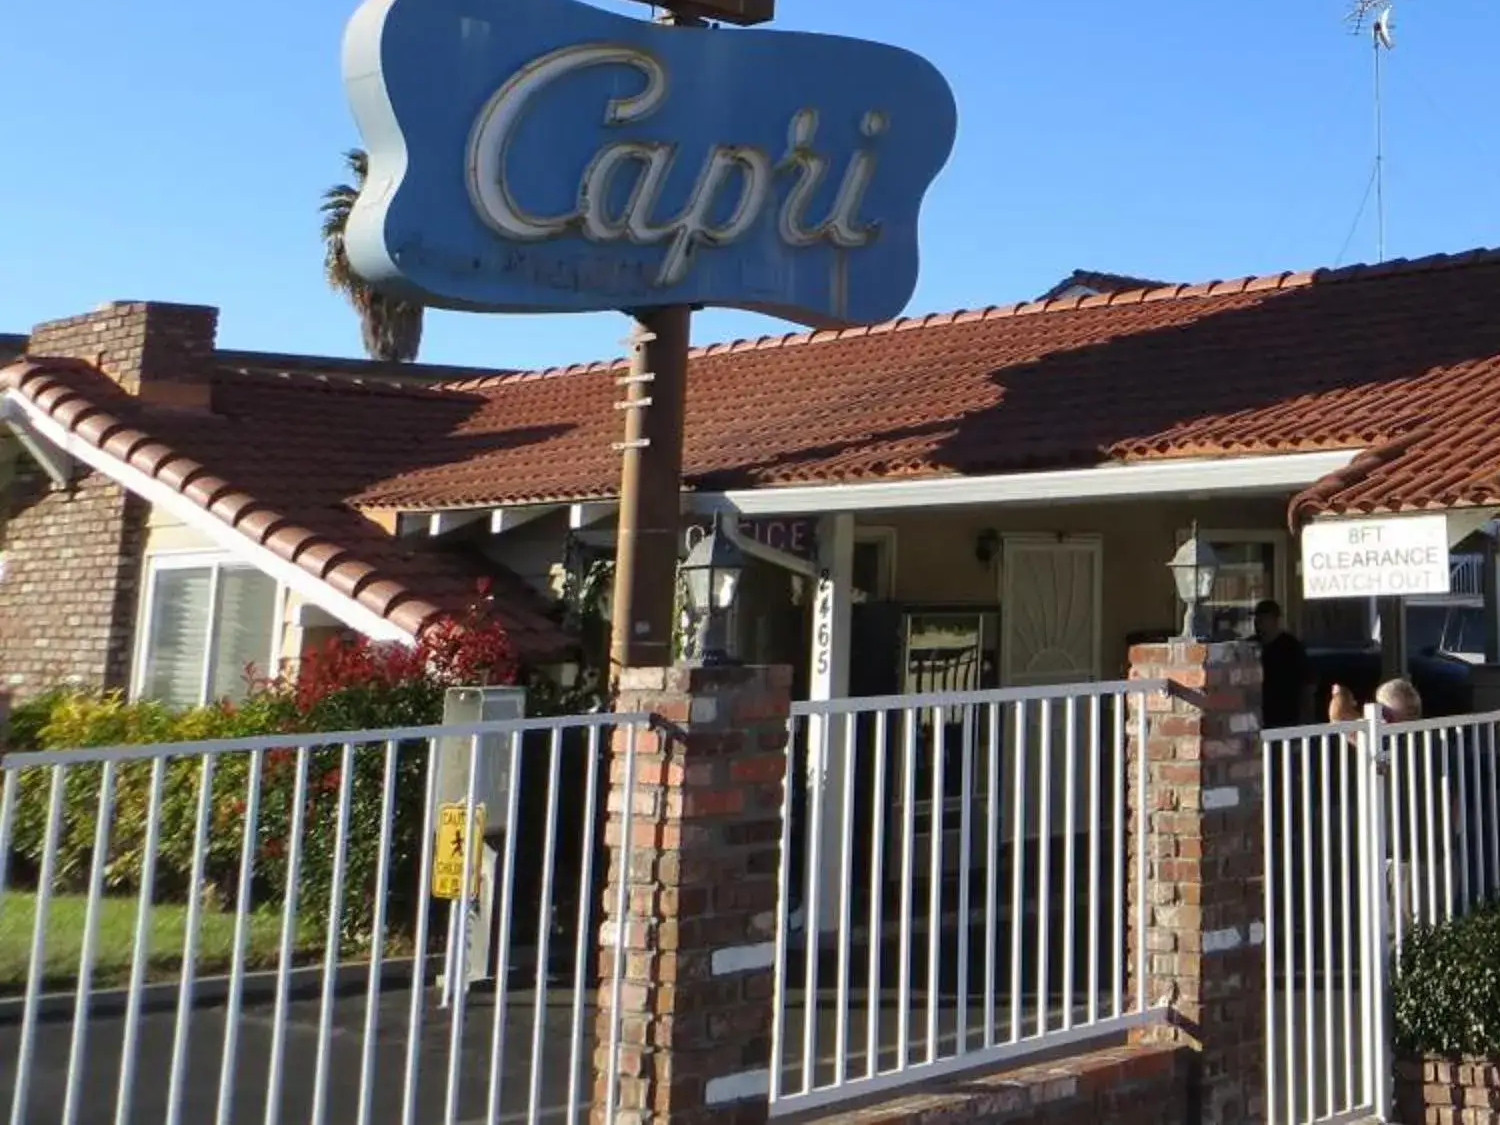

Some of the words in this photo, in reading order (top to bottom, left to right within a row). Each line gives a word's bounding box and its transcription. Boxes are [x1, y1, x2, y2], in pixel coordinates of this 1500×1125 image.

[465, 42, 889, 287] Capri
[685, 521, 808, 552] OICE
[1310, 546, 1438, 570] CLEARANCE
[1309, 573, 1382, 593] WATCH
